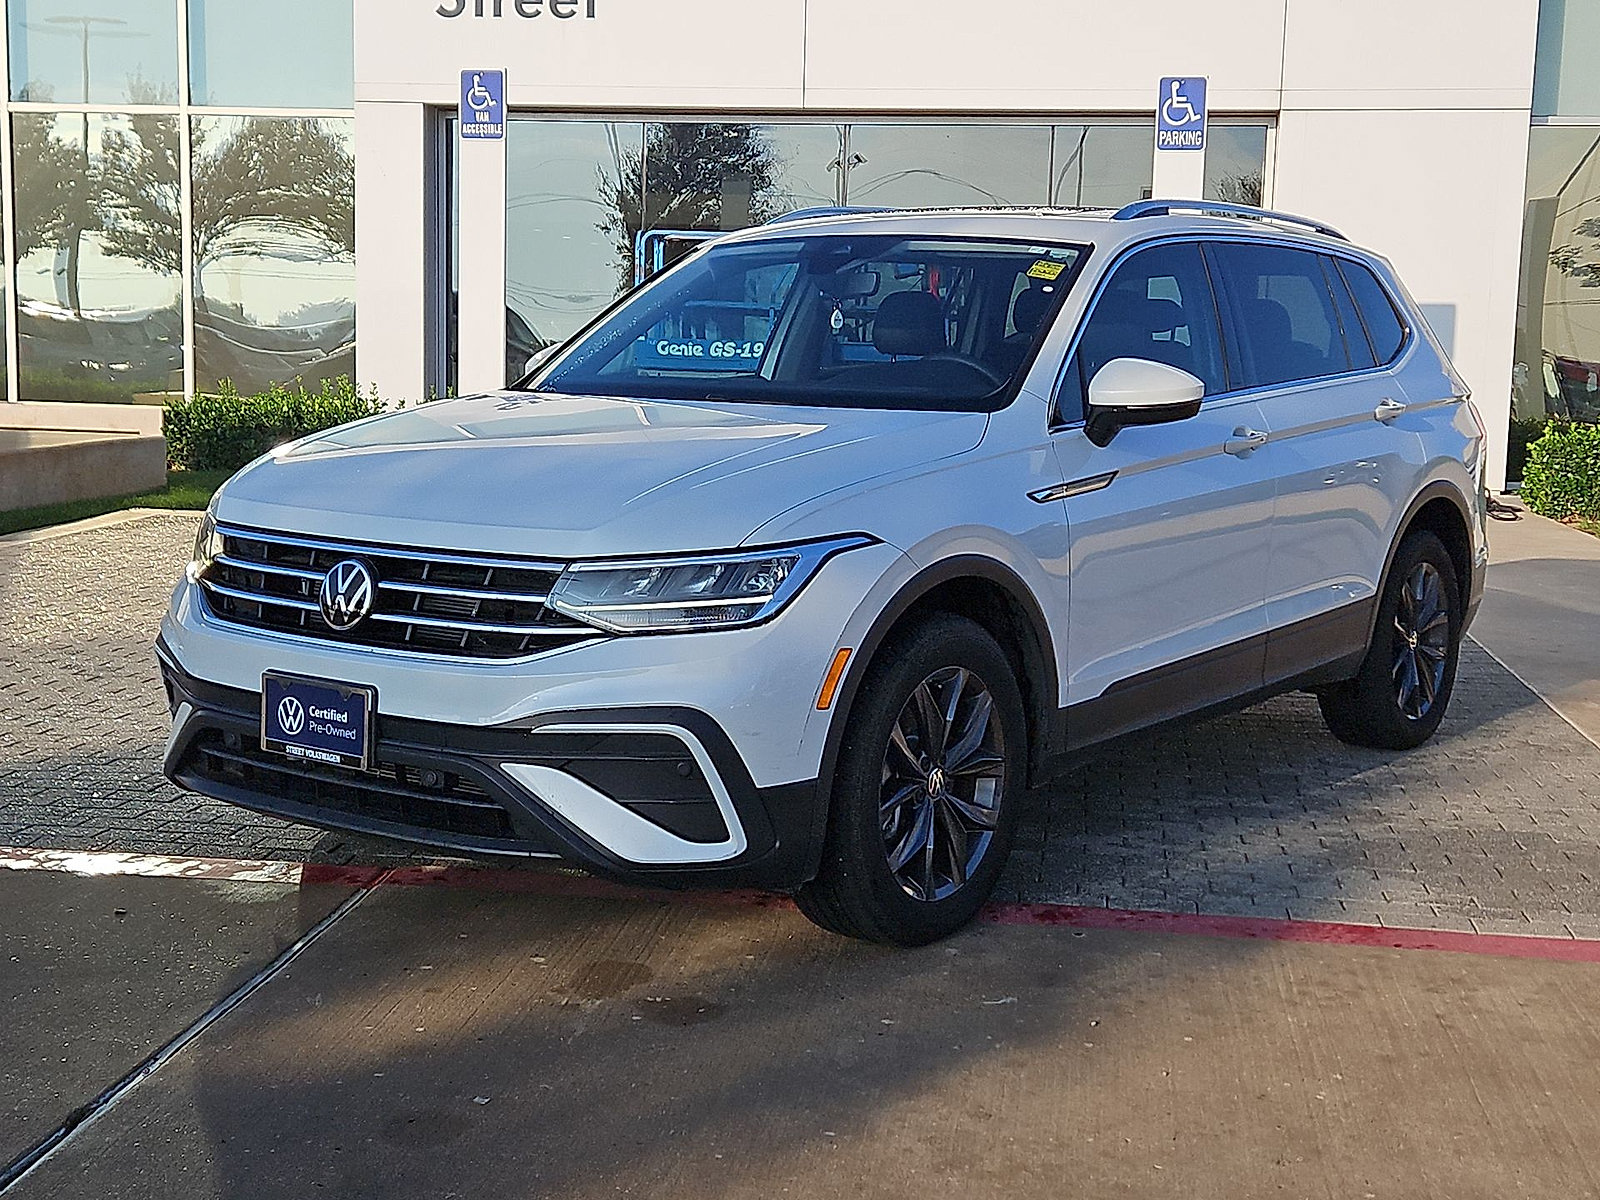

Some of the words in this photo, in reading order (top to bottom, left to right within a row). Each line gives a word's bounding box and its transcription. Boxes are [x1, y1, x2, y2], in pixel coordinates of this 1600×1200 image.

[475, 111, 490, 122] VAN
[462, 123, 502, 135] ACCESSIBLE
[1159, 130, 1202, 146] PARKING
[656, 340, 703, 357] Genie
[309, 706, 348, 723] Certified
[309, 721, 356, 740] Pre-Owned
